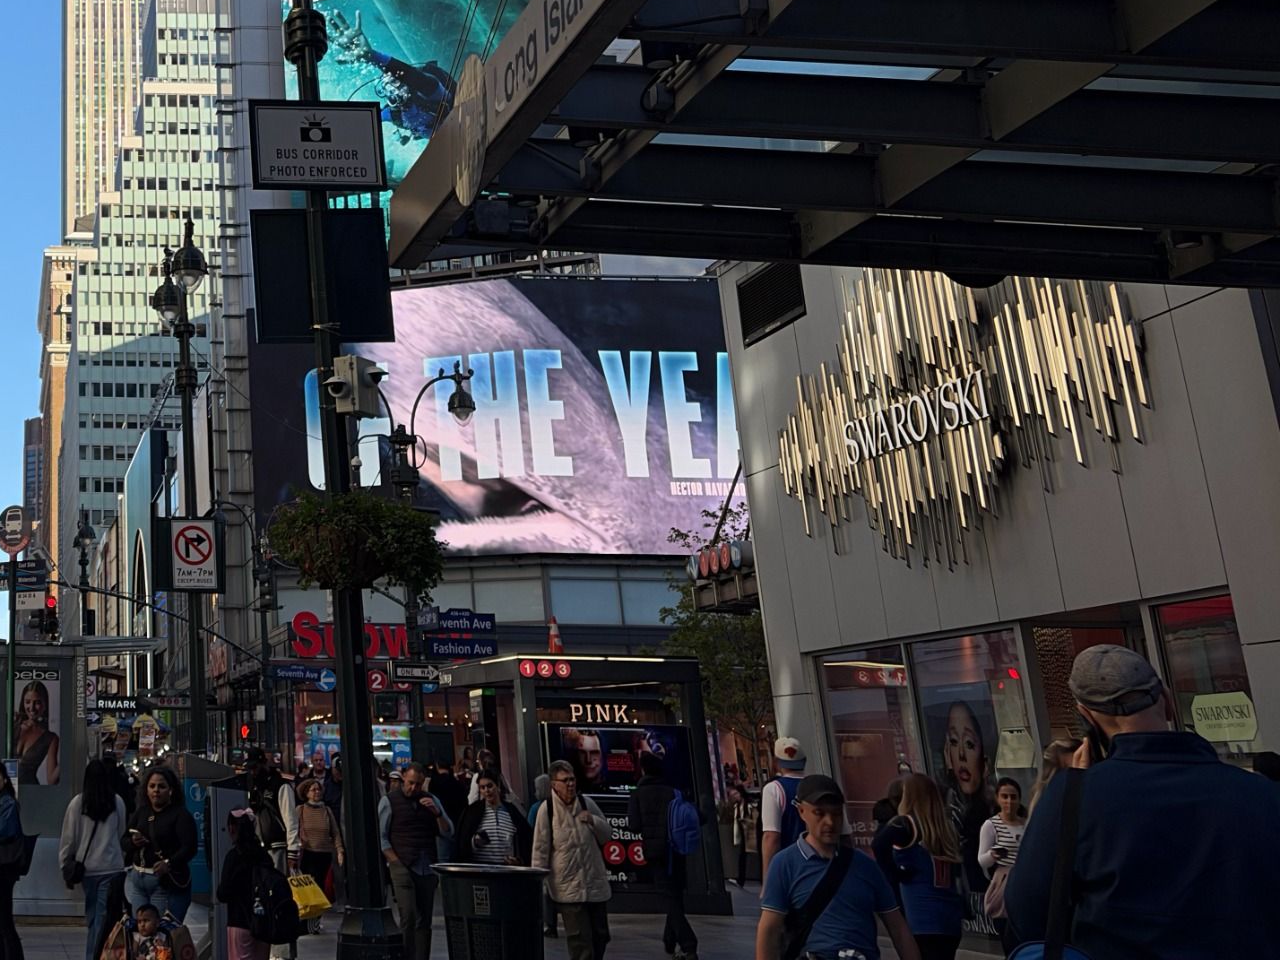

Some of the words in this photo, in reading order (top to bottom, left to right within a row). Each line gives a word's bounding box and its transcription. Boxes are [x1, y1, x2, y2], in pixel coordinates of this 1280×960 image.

[494, 37, 539, 114] Long
[276, 148, 298, 160] BUS
[303, 149, 359, 161] CORRIDOR
[269, 165, 306, 177] PHOTO
[310, 166, 368, 178] ENFORCED
[423, 348, 575, 481] THE
[844, 369, 990, 466] SWAROVSKI
[670, 481, 703, 496] HECTOR
[440, 618, 470, 629] venth
[473, 618, 492, 630] Ave
[433, 642, 471, 654] Fashion
[474, 643, 493, 655] Ave
[276, 669, 304, 679] Seventh
[305, 670, 318, 680] Ave
[400, 668, 415, 676] ONE
[76, 656, 86, 719] Newsstand
[97, 699, 136, 709] RIMARK
[570, 703, 630, 724] PINK
[1195, 704, 1251, 721] SWAROVSKI
